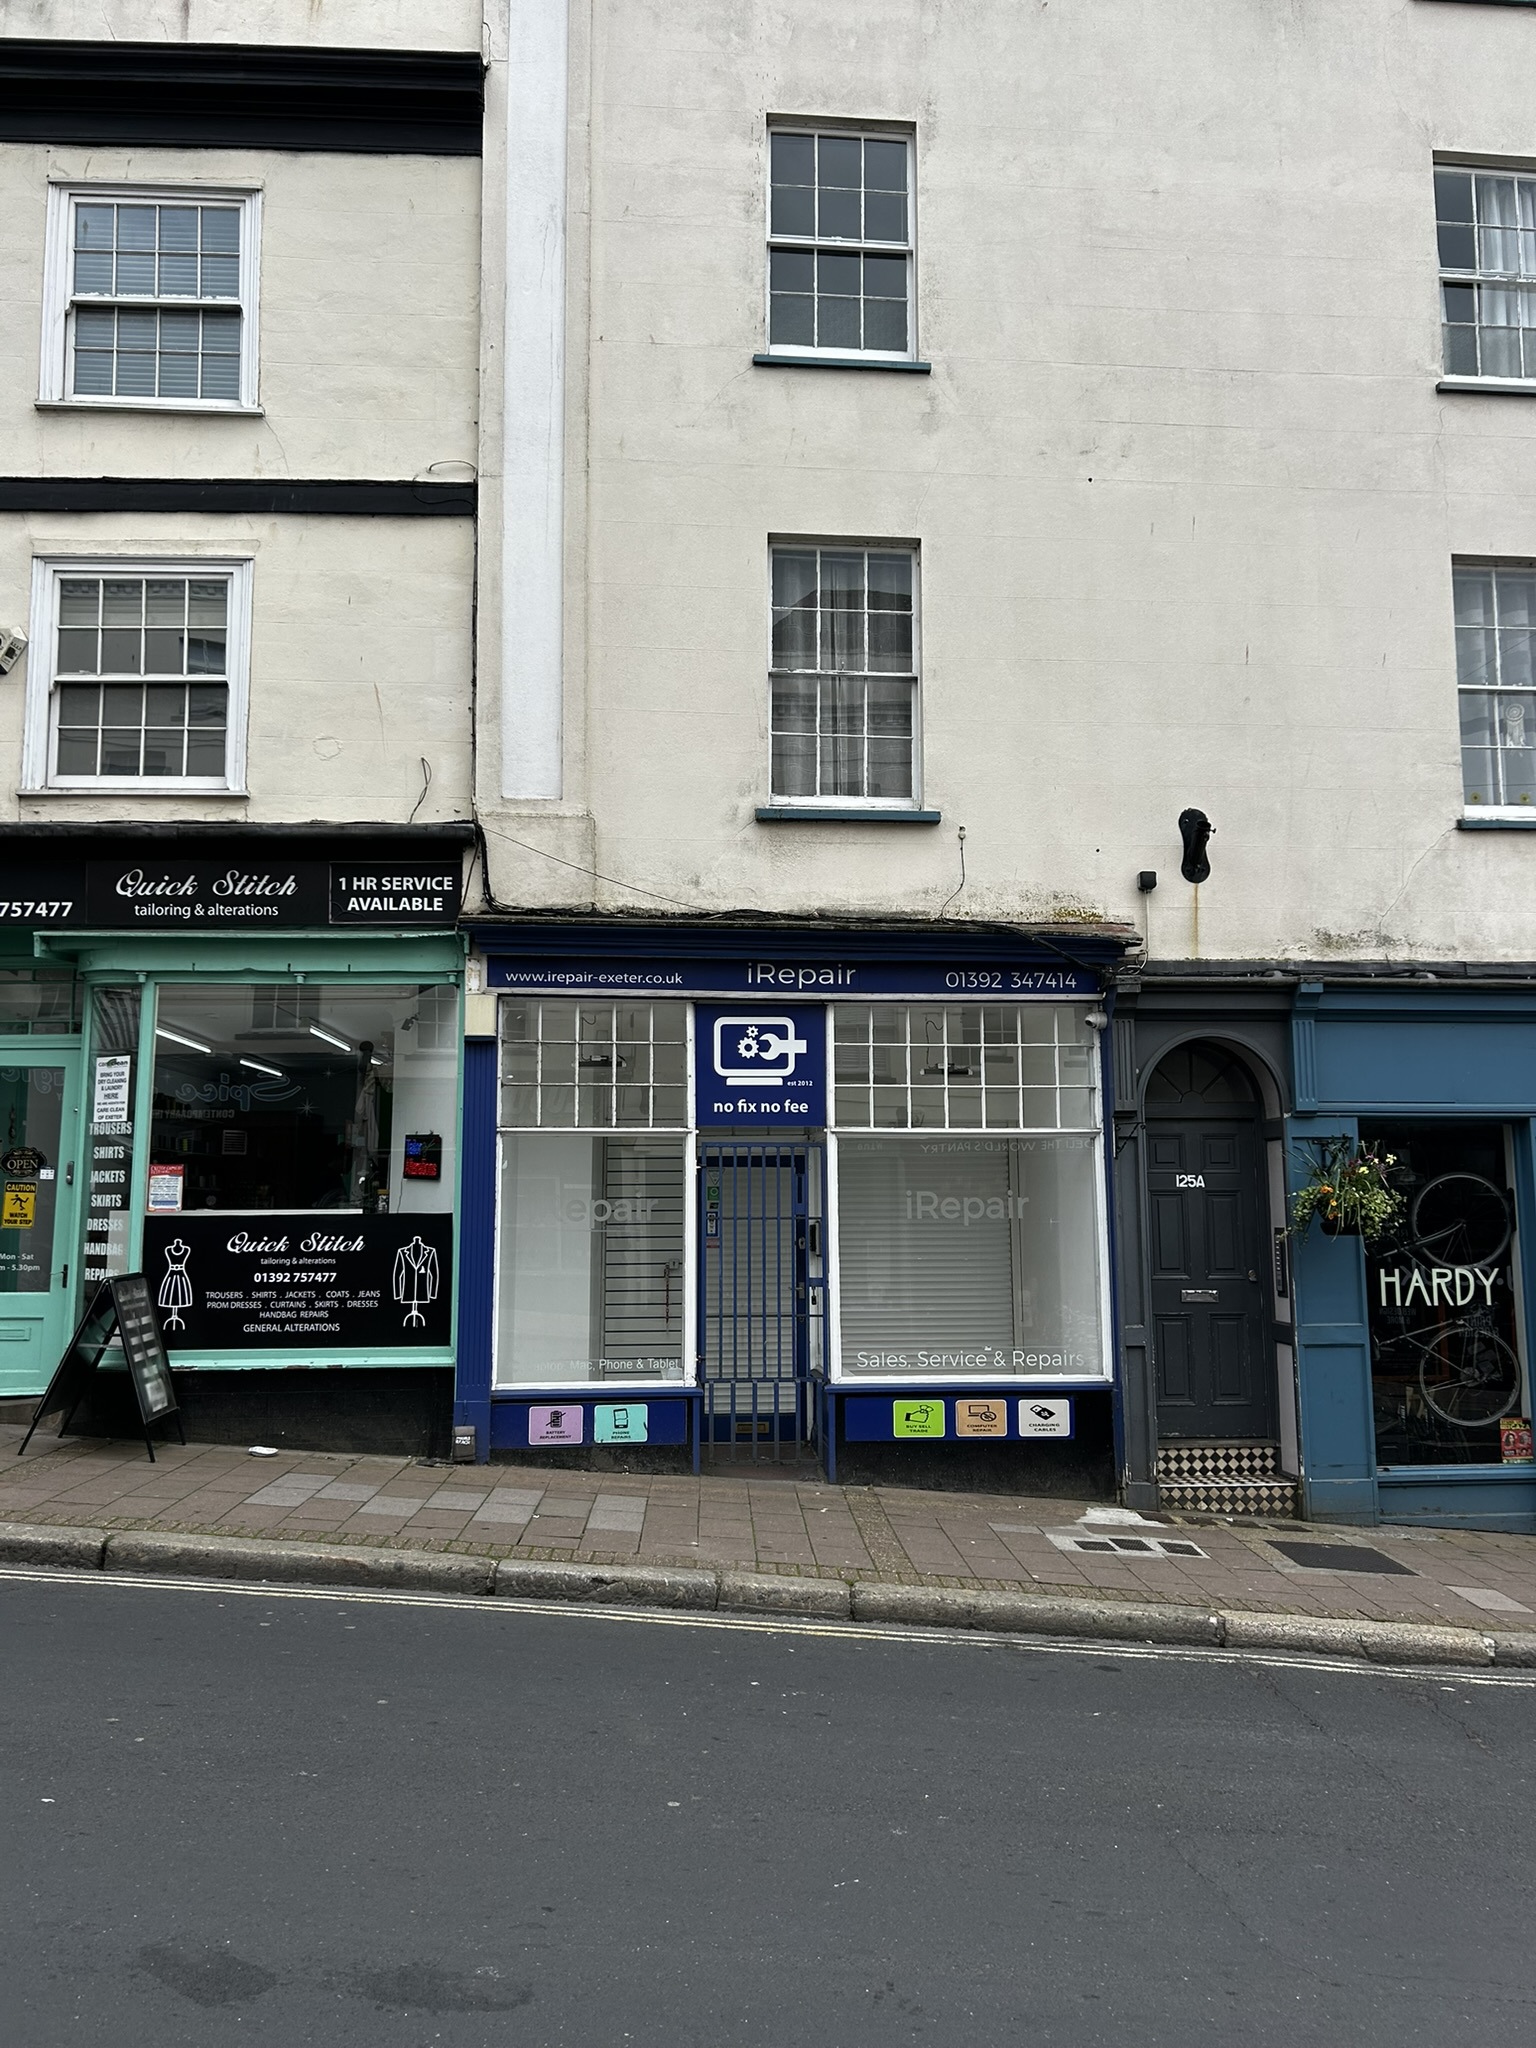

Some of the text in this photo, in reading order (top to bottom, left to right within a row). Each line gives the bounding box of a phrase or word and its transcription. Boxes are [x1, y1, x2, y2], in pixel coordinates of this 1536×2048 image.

[115, 868, 298, 897] Quick Stitch
[338, 876, 453, 890] 1 HR SERVICE
[0, 902, 73, 917] 757477
[347, 897, 443, 911] AVAILABLE
[134, 903, 279, 919] tailoring & alterations
[506, 971, 683, 985] www.irepair-exeter.co.uk
[747, 963, 856, 989] iRepair
[945, 972, 1077, 989] 01392 347414
[713, 1099, 809, 1113] no fix no fee
[89, 1122, 133, 1135] TROUSERS
[93, 1146, 125, 1159] SHIRTS
[7, 1159, 38, 1170] OPEN
[90, 1170, 126, 1183] JACKETS
[1176, 1174, 1205, 1188] 125A
[91, 1194, 122, 1207] SKIRTS
[563, 1193, 659, 1229] epair
[906, 1190, 1029, 1226] iRepair
[86, 1218, 124, 1231] DRESSES
[83, 1242, 124, 1255] HANDBAG
[226, 1231, 365, 1254] Quick Stitch
[12, 1264, 40, 1272] 5.30pm
[260, 1257, 337, 1266] tailoring & alterations
[253, 1272, 337, 1283] 01392 757477
[1379, 1268, 1499, 1306] HARDY
[205, 1290, 381, 1299] TROUSERS SHIRTS JACKETS COATS JEANS
[207, 1301, 229, 1309] PROM
[231, 1301, 262, 1309] DRESSES
[270, 1301, 306, 1309] CURTAINS
[347, 1300, 379, 1308] DRESSES
[300, 1310, 329, 1318] REPAIRS
[243, 1323, 340, 1332] GENERAL ALTERATIONS
[570, 1360, 595, 1371] Mac,
[599, 1359, 633, 1370] Phone
[636, 1359, 644, 1369] &
[647, 1358, 680, 1369] Tablet
[856, 1350, 1084, 1370] Sales, Service & Repairs
